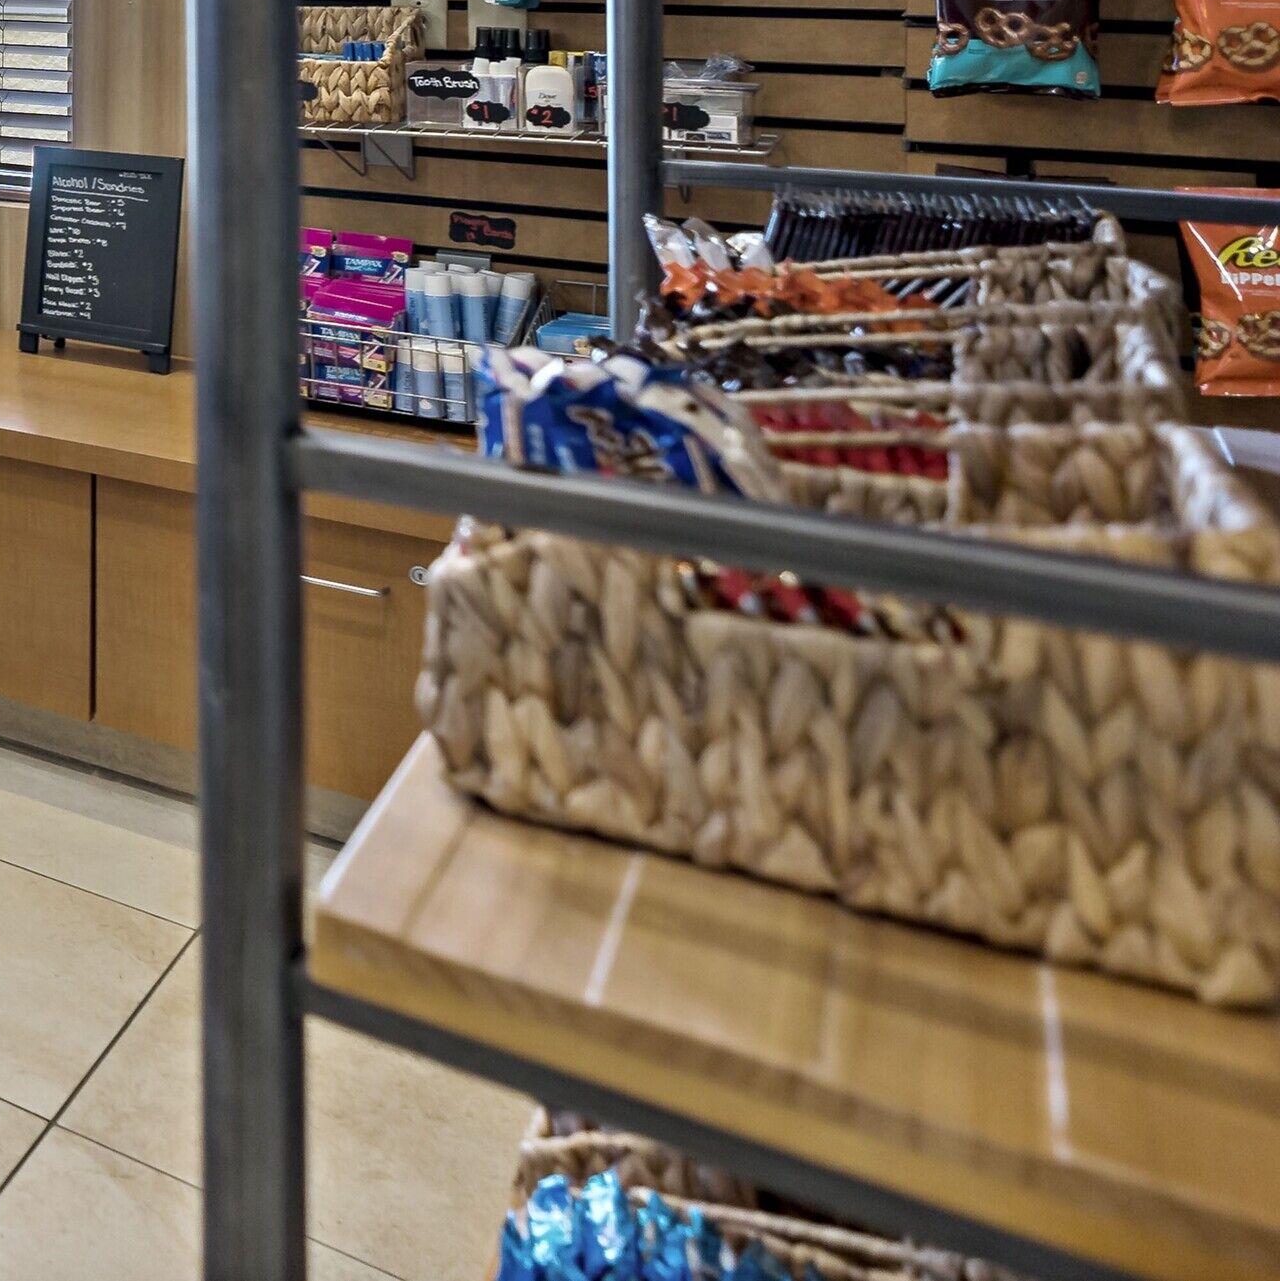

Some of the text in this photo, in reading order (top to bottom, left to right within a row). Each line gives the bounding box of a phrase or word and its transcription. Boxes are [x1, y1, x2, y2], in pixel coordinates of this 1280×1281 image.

[409, 75, 480, 90] Tooth Brush
[531, 106, 553, 125] $2
[52, 175, 89, 189] Alcohol
[344, 257, 383, 268] TAMPAX
